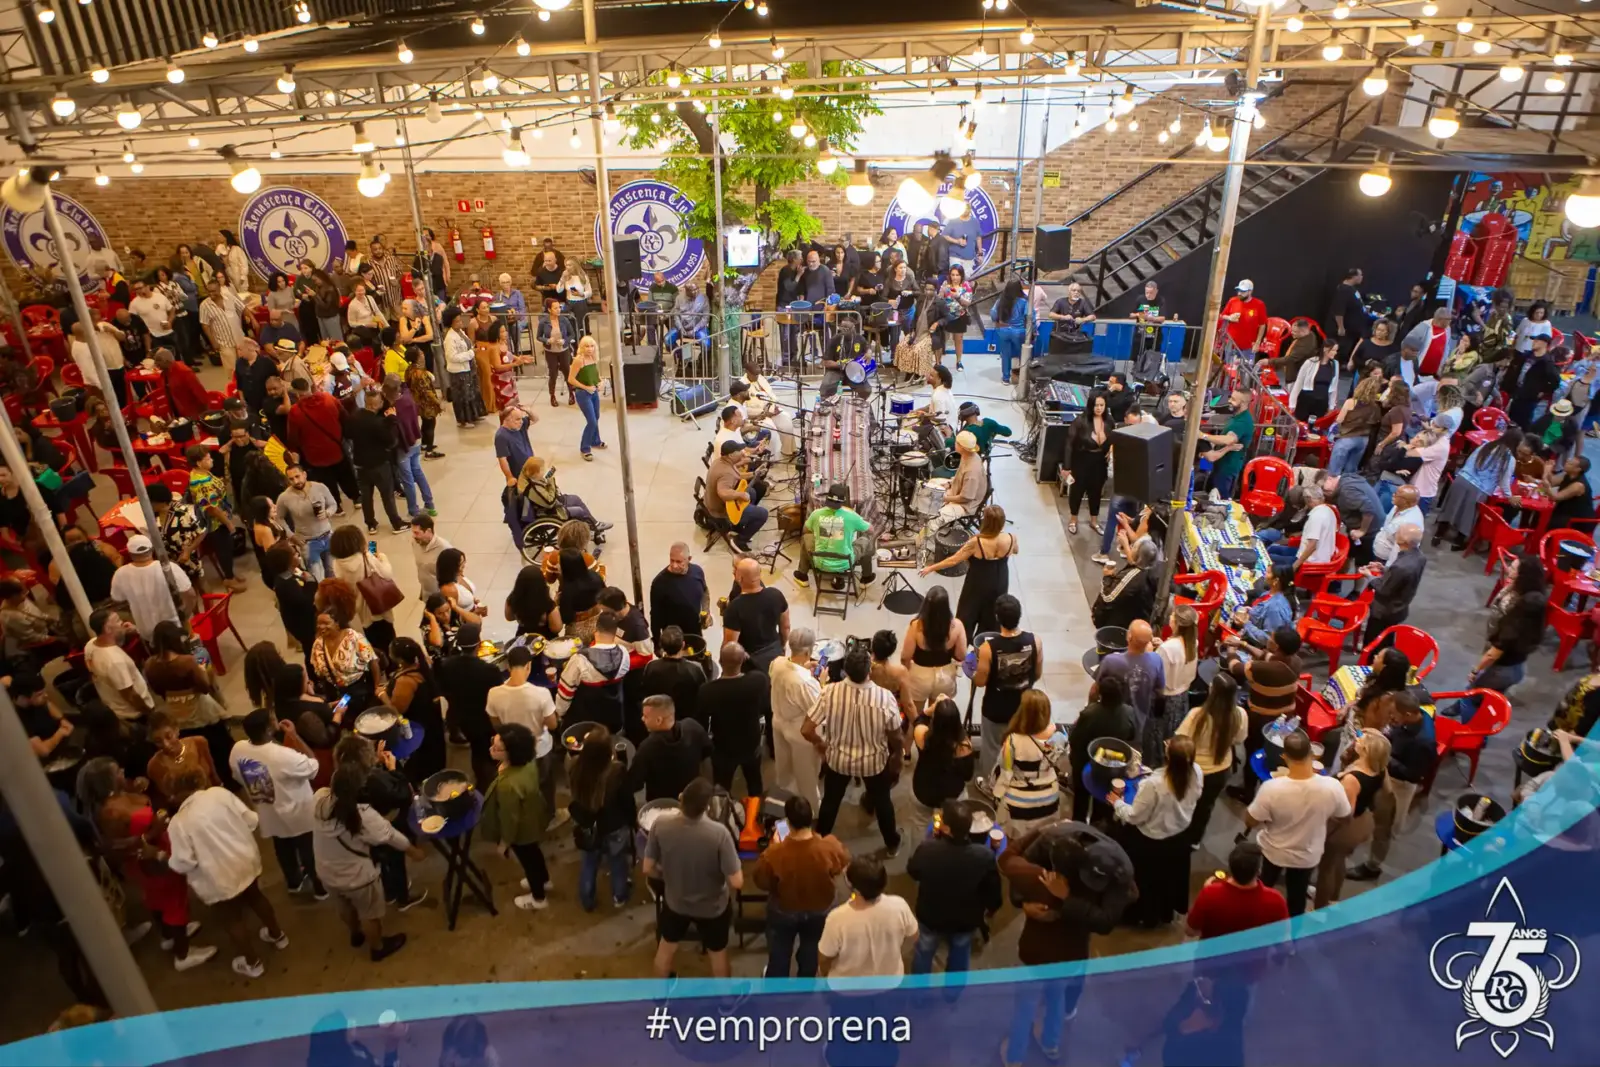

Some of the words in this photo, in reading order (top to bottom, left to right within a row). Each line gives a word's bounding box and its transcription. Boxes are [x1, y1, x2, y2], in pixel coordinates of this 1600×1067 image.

[244, 194, 301, 232] Renascença
[303, 197, 335, 231] Clube
[610, 188, 667, 222] enascença
[688, 252, 699, 267] 1951
